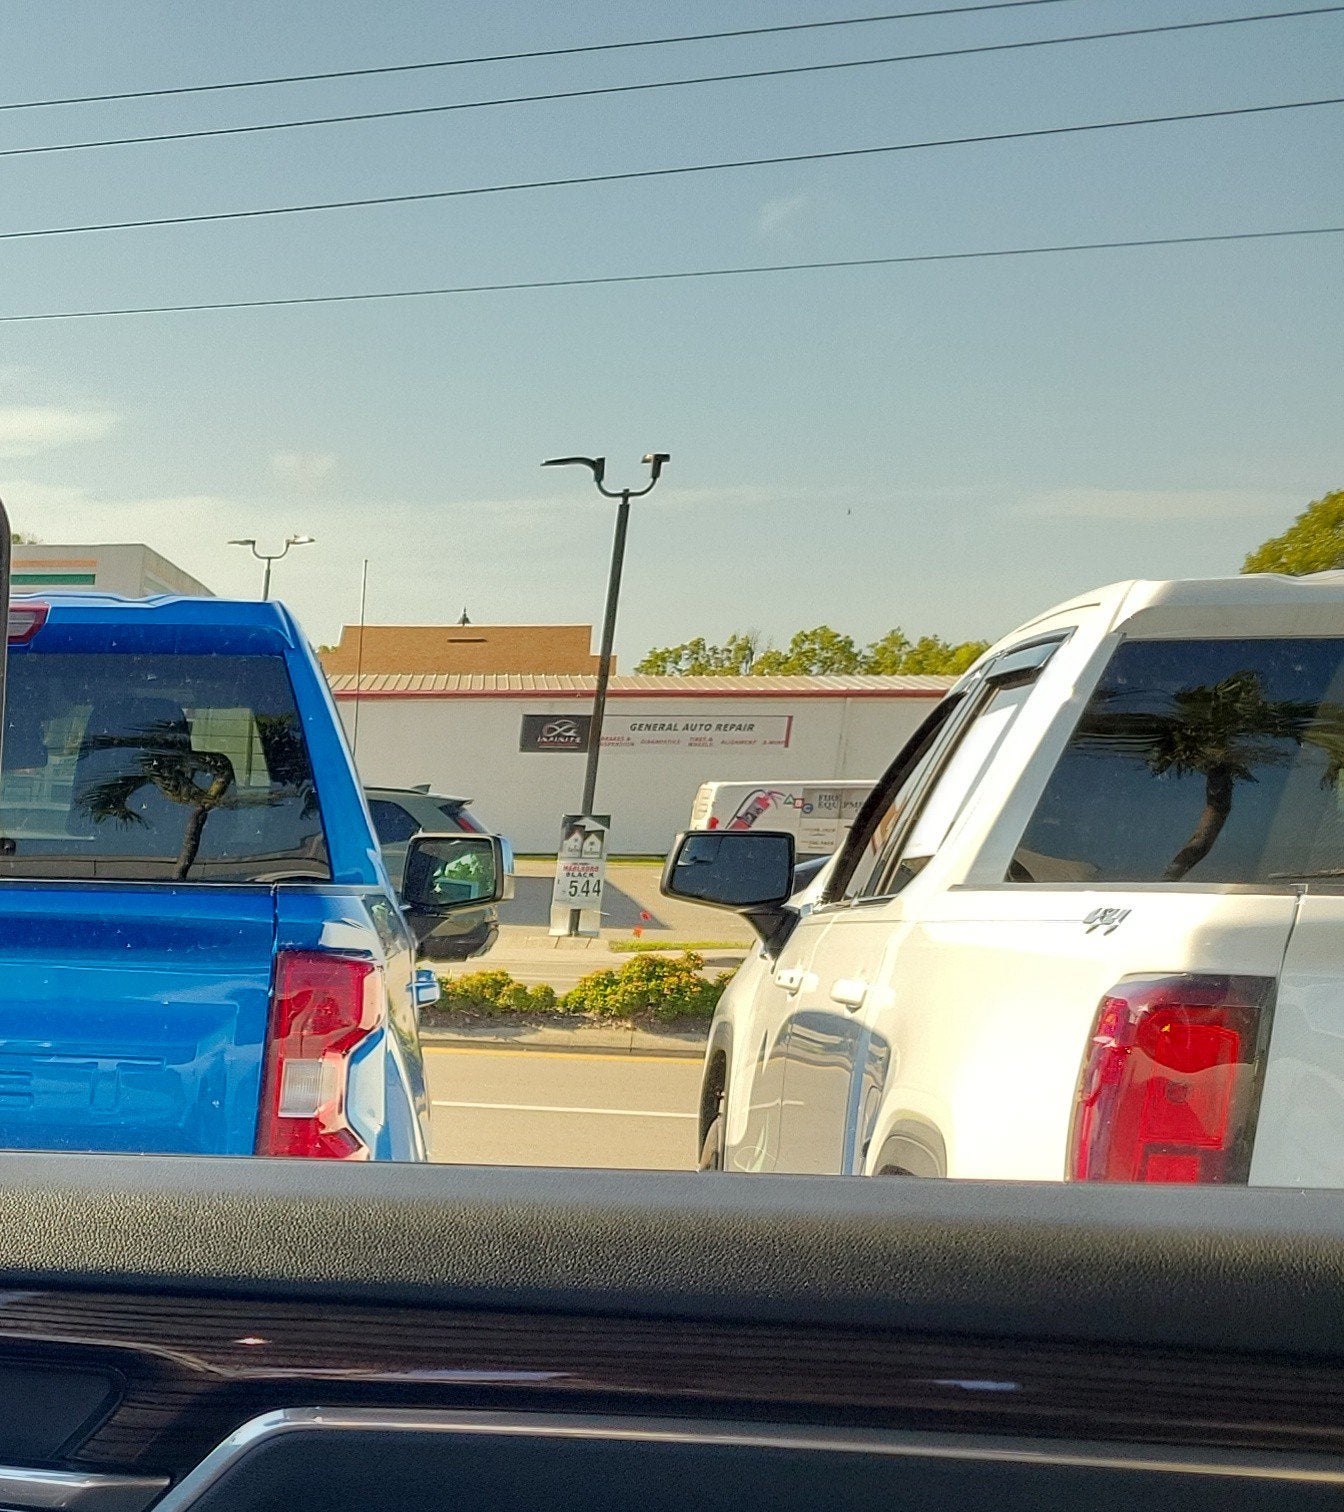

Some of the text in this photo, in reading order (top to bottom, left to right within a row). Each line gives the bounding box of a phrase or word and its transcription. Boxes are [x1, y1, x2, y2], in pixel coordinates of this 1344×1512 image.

[629, 723, 756, 732] GENERAL AUTO REPAIR
